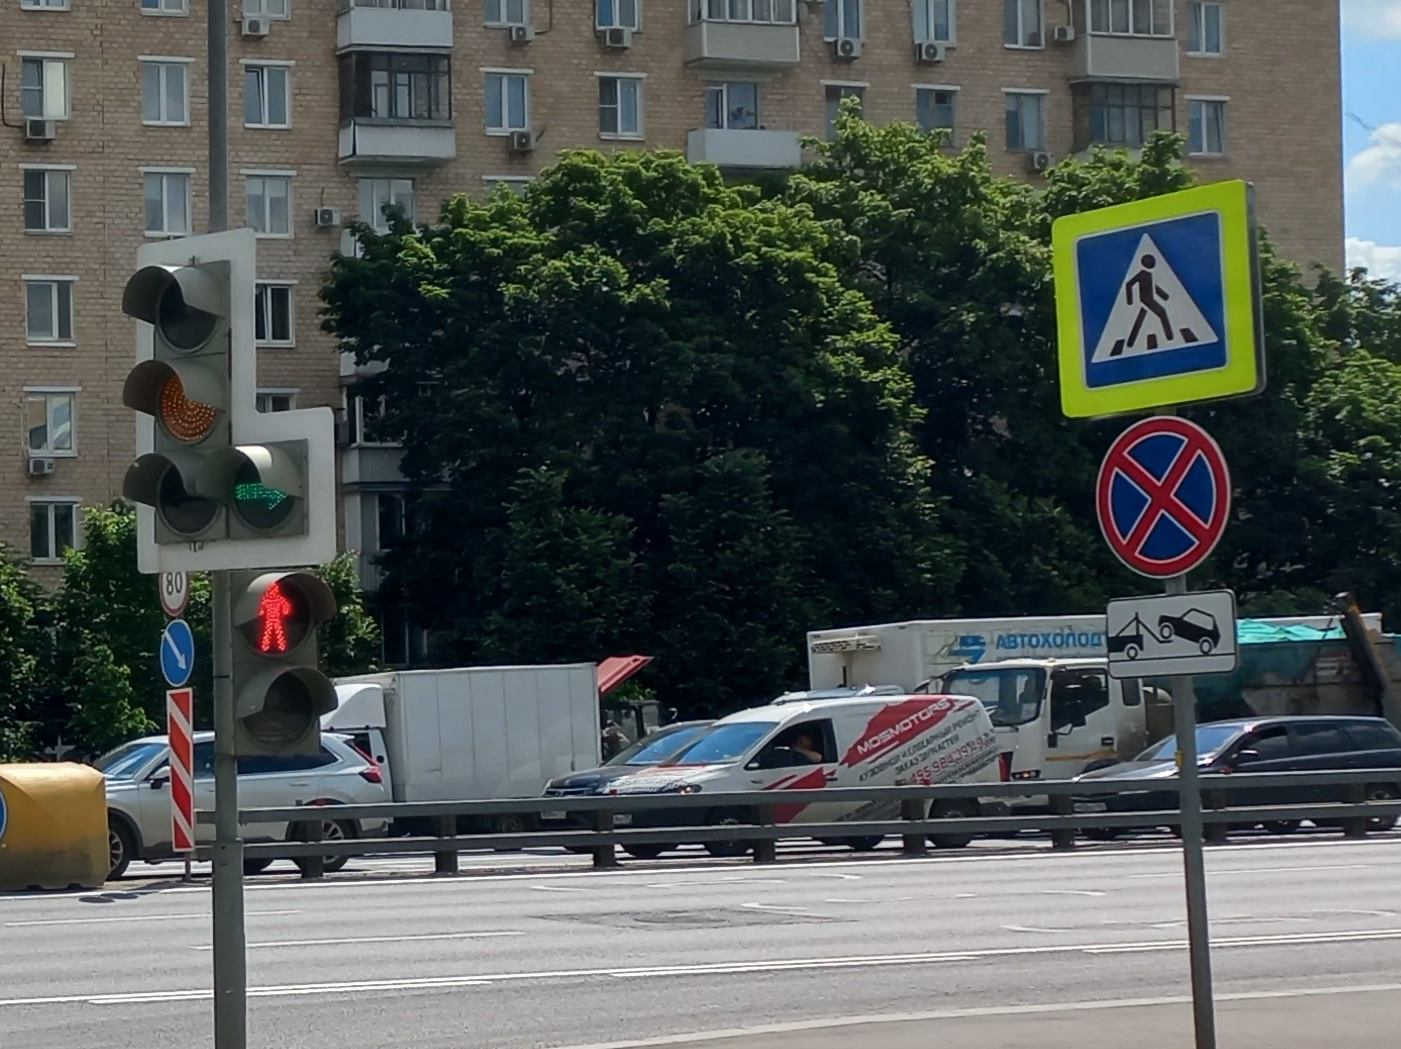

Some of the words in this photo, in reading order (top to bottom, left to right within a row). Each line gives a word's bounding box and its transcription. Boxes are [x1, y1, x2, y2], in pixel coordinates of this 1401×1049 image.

[166, 571, 183, 596] 80
[996, 632, 1107, 650] АВТОХОЛОД
[856, 697, 951, 755] MOSMOTORS
